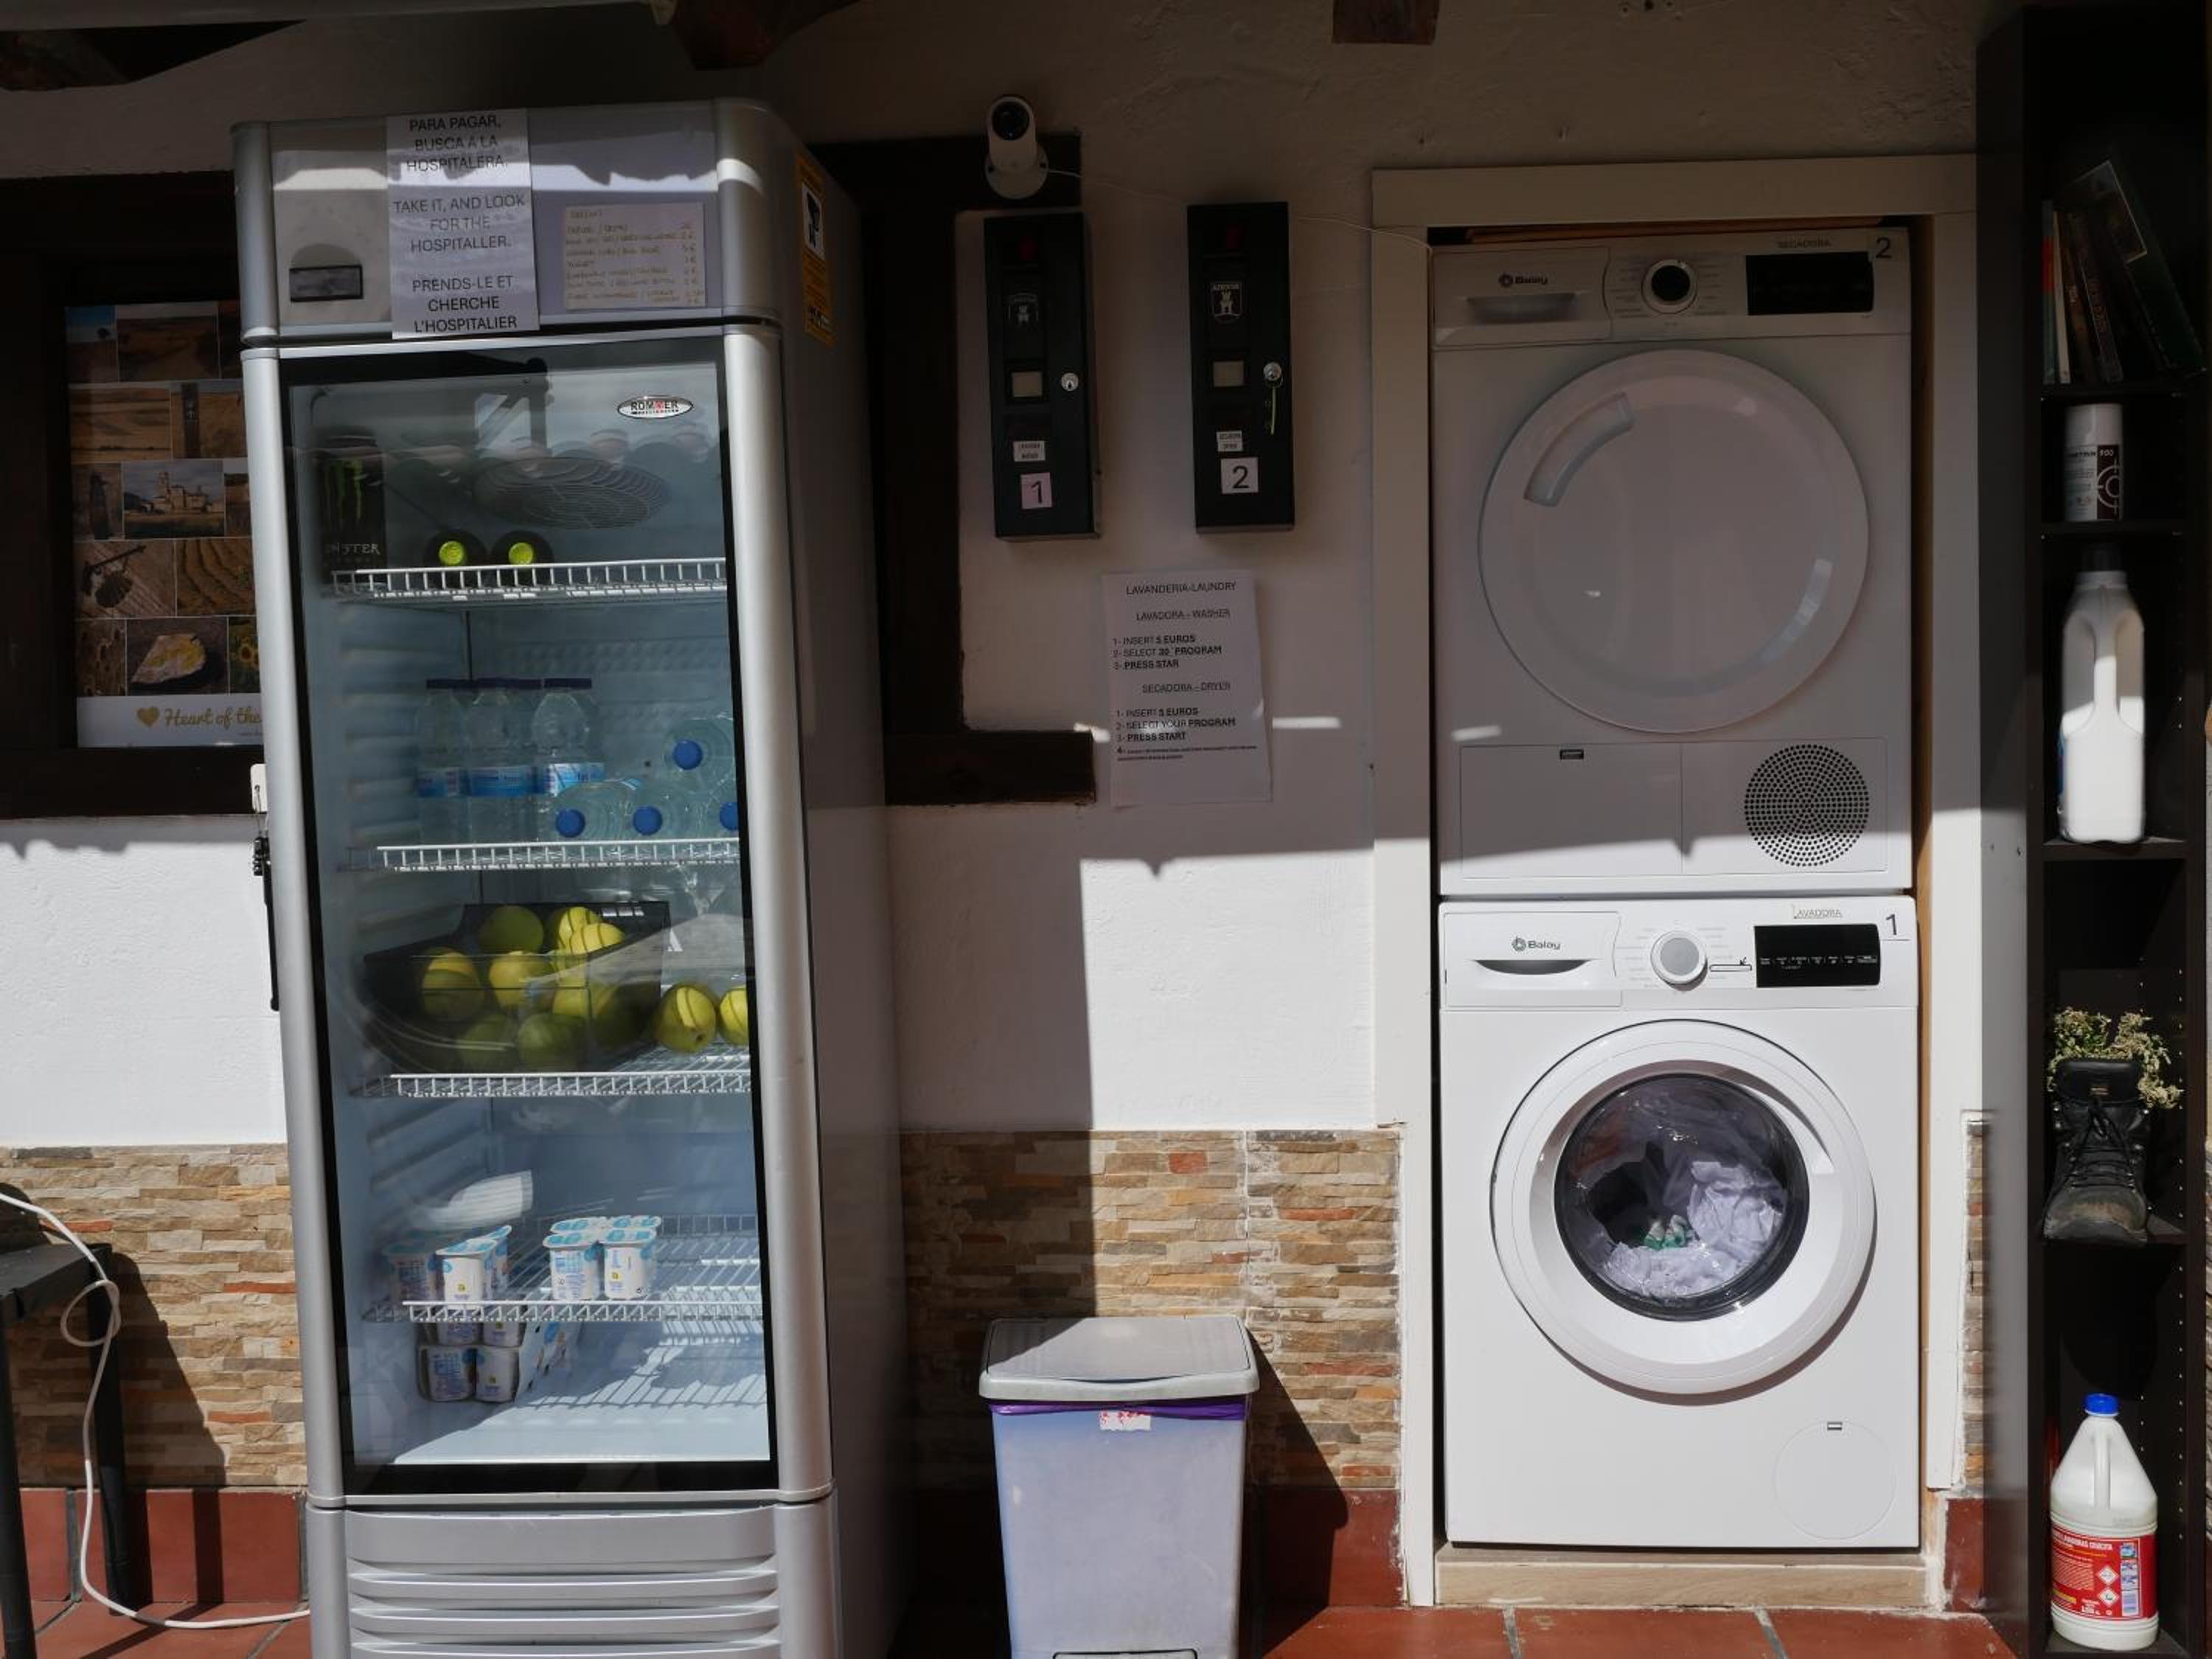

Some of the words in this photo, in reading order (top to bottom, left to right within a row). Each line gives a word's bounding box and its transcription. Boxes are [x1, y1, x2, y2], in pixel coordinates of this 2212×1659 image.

[409, 118, 446, 132] PARA
[414, 136, 464, 151] BUSCA
[467, 135, 477, 148] A
[480, 133, 498, 147] LA
[392, 199, 428, 213] TAKE
[431, 198, 447, 212] IT,
[450, 195, 481, 211] AND
[485, 193, 525, 209] LOOK
[430, 217, 459, 232] FOR
[463, 215, 490, 230] THE
[411, 235, 512, 252] HOSPITALLER.
[1875, 236, 1893, 259] 2
[412, 276, 493, 293] PRENDS-LE
[497, 274, 514, 288] ET
[428, 295, 500, 312] CHERCHE
[413, 315, 518, 333] L'HOSPITALIER
[1232, 465, 1250, 490] 2
[1031, 480, 1043, 505] 1
[1136, 611, 1183, 622] LAVADORA
[1192, 608, 1231, 619] WASHER
[1123, 636, 1154, 645] INSERT
[1164, 634, 1196, 644] EUROS
[1123, 647, 1157, 657] SELECT
[1175, 645, 1223, 655] PROGRAM
[1124, 660, 1154, 669] PRESS
[1155, 658, 1180, 669] STAR
[1141, 683, 1193, 694] SECADORA
[1201, 681, 1231, 692] DRYER
[164, 706, 214, 726] Heart
[215, 706, 235, 731] of
[1126, 708, 1157, 717] INSERT
[1166, 706, 1199, 717] EUROS
[1126, 720, 1160, 730] SELECT
[1161, 718, 1186, 728] YOUR
[1188, 717, 1237, 728] PROGRAM
[1127, 733, 1158, 742] PRESS
[1158, 731, 1186, 741] START
[1885, 913, 1897, 936] 1
[1527, 939, 1562, 951] Balay
